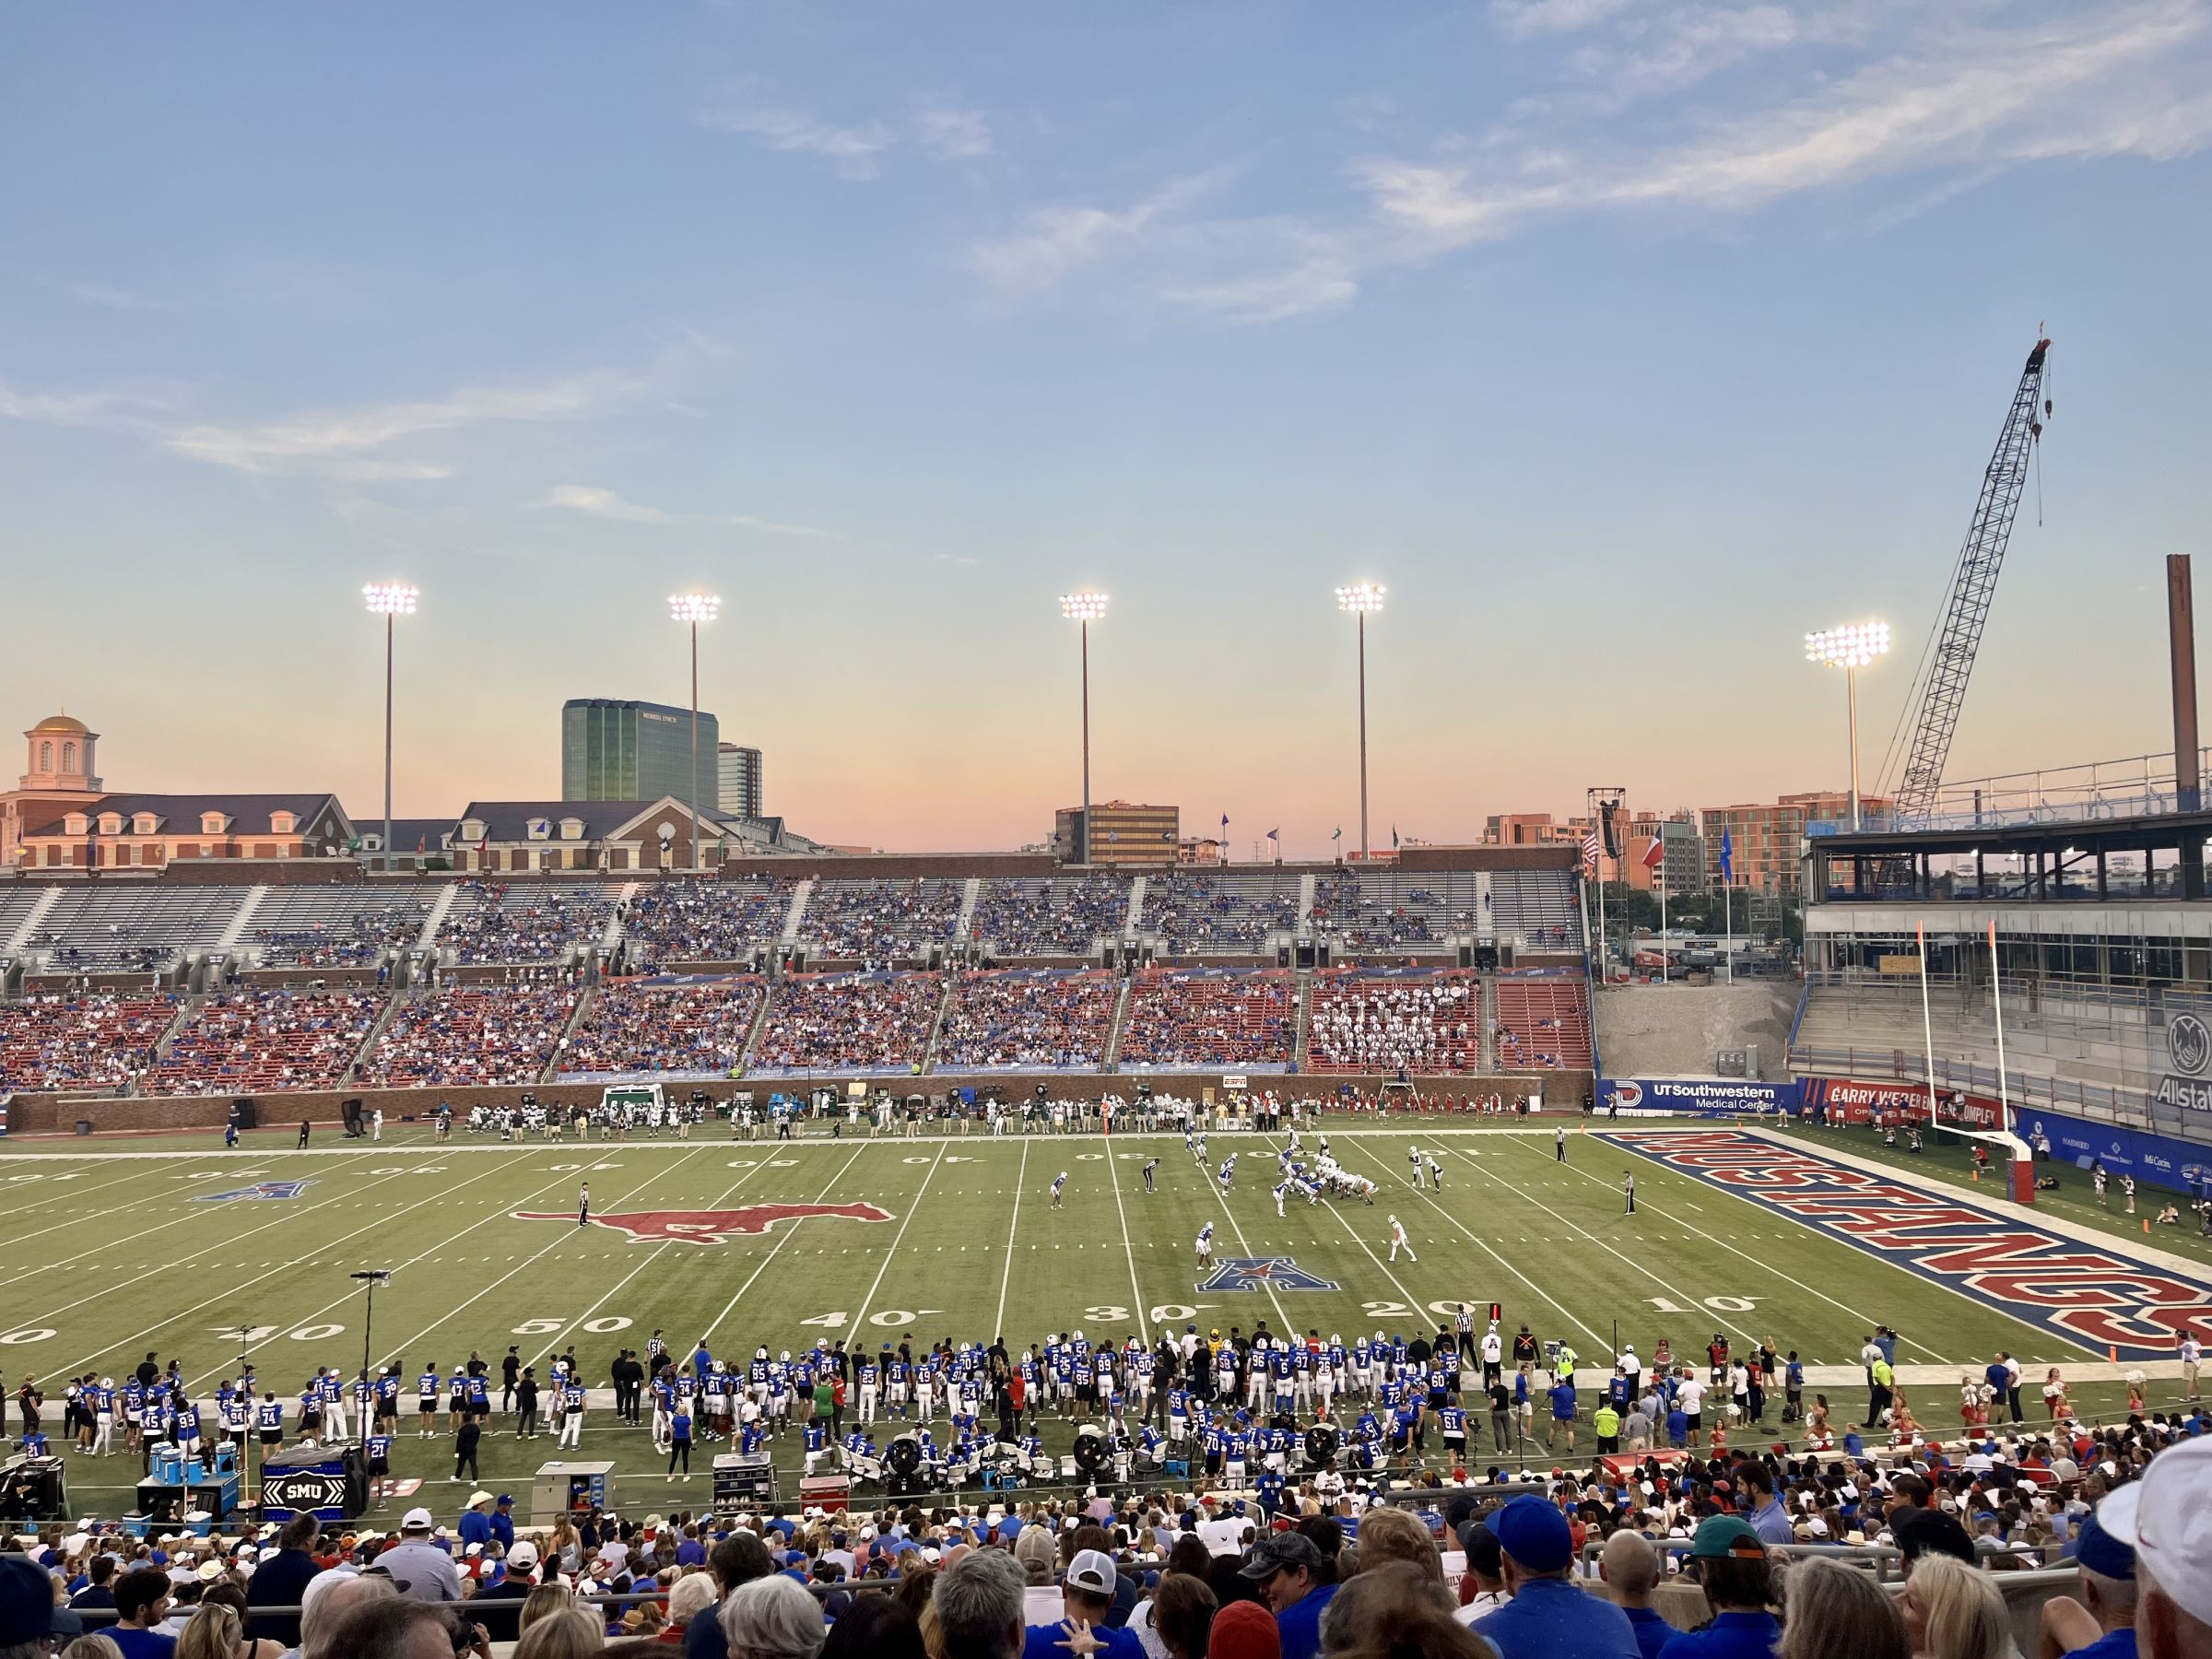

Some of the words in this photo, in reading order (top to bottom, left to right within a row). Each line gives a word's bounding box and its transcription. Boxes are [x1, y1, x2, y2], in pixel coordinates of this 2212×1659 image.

[1831, 1087, 1877, 1104] GARRY
[1696, 1099, 1737, 1109] Medical
[1738, 1100, 1775, 1111] Cener
[1612, 1130, 2212, 1352] MUSTANGS
[1360, 1300, 1477, 1317] 20
[1641, 1295, 1757, 1313] 10
[799, 1310, 917, 1328] 40
[1083, 1304, 1197, 1322] 30
[511, 1316, 633, 1335] 50
[1076, 1346, 1088, 1357] 54
[1395, 1350, 1406, 1362] 14
[1098, 1359, 1111, 1371] 89
[1138, 1360, 1152, 1372] 90
[1252, 1356, 1265, 1368] 96
[1296, 1356, 1308, 1368] 97
[1359, 1354, 1366, 1366] 7
[1445, 1360, 1457, 1372] 32
[820, 1364, 832, 1374] 84
[1280, 1362, 1288, 1374] 6
[1318, 1360, 1331, 1373] 36
[752, 1367, 765, 1381] 85
[795, 1370, 806, 1381] 36
[862, 1373, 875, 1384] 25
[892, 1368, 901, 1379] 31
[918, 1371, 931, 1382] 49
[1021, 1368, 1032, 1380] 16
[1076, 1374, 1088, 1385] 95
[420, 1382, 430, 1393] 35
[1431, 1376, 1444, 1388] 60
[385, 1383, 397, 1398] 39
[451, 1384, 463, 1396] 47
[678, 1384, 690, 1394] 34
[963, 1387, 976, 1398] 24
[98, 1395, 109, 1408] 41
[324, 1390, 336, 1401] 91
[568, 1394, 581, 1406] 33
[1388, 1391, 1401, 1405] 72
[127, 1397, 141, 1409] 32
[145, 1415, 159, 1429] 45
[230, 1412, 243, 1423] 94
[262, 1414, 276, 1424] 74
[1444, 1417, 1456, 1430] 61
[1149, 1429, 1159, 1441] 14
[808, 1435, 814, 1448] 1
[847, 1437, 854, 1448] 5
[1021, 1441, 1032, 1453] 27
[1206, 1435, 1219, 1452] 70
[1271, 1436, 1285, 1451] 77
[28, 1445, 39, 1457] 21
[371, 1444, 384, 1458] 21
[1231, 1441, 1244, 1455] 79
[1370, 1444, 1383, 1459] 51
[287, 1484, 323, 1500] SMU
